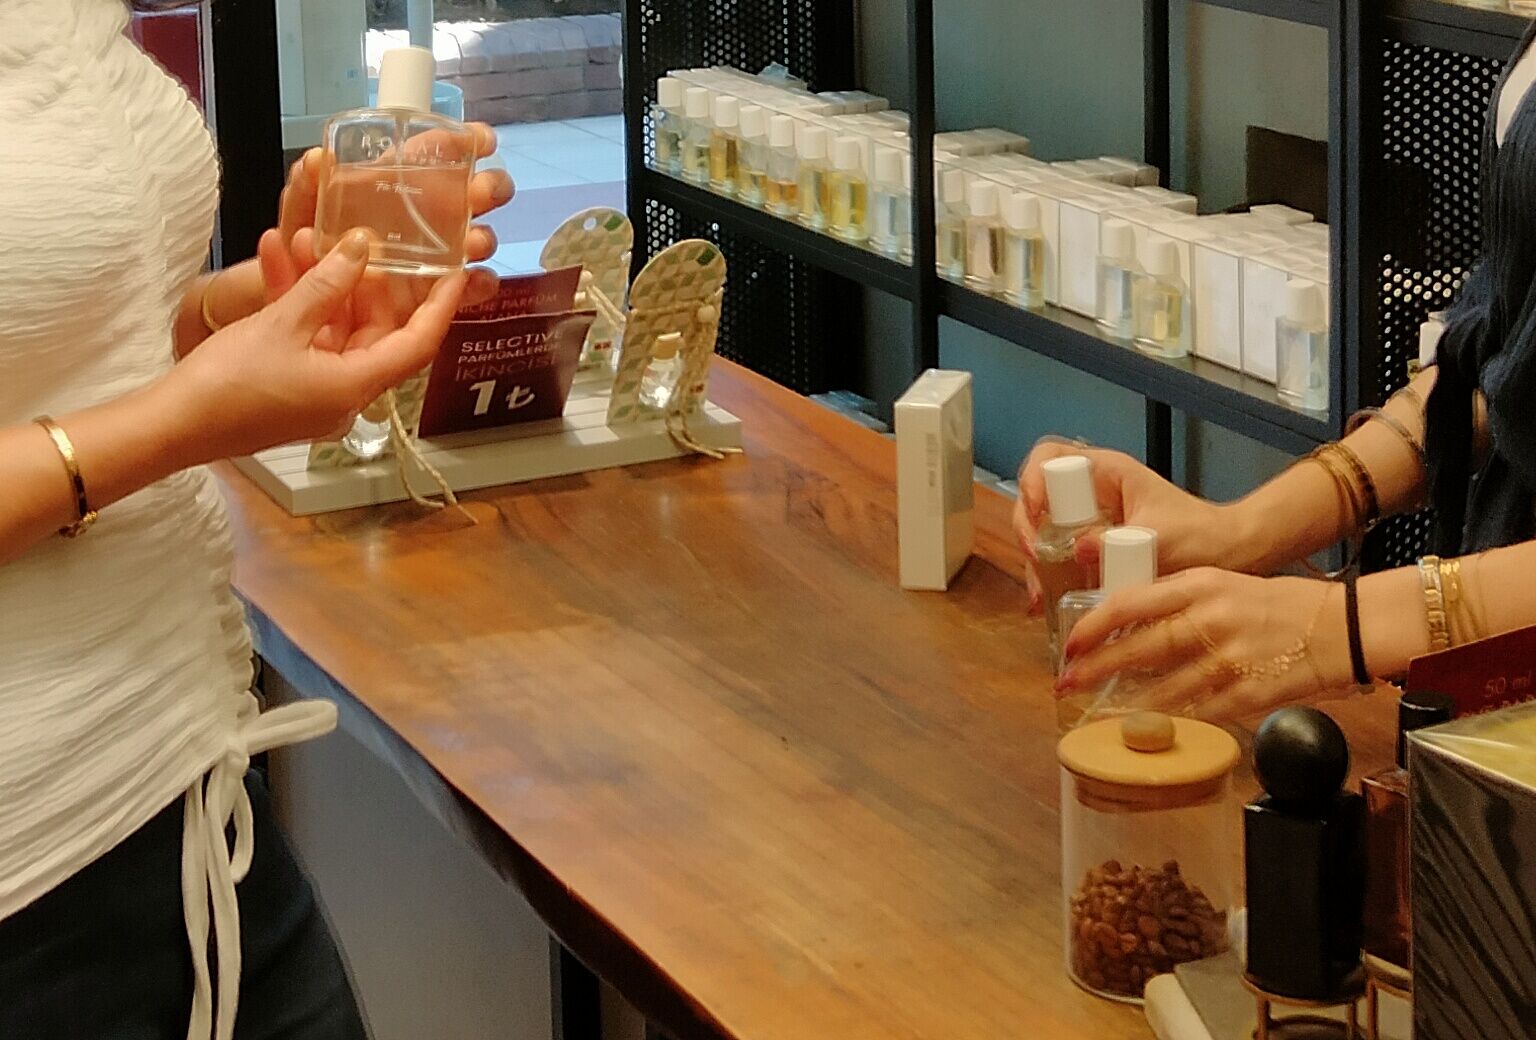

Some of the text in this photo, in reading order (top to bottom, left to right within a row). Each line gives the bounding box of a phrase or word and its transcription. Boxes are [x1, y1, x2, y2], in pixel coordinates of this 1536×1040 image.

[461, 329, 563, 353] SELECTIVE
[469, 379, 496, 416] 1
[1484, 676, 1507, 698] 50
